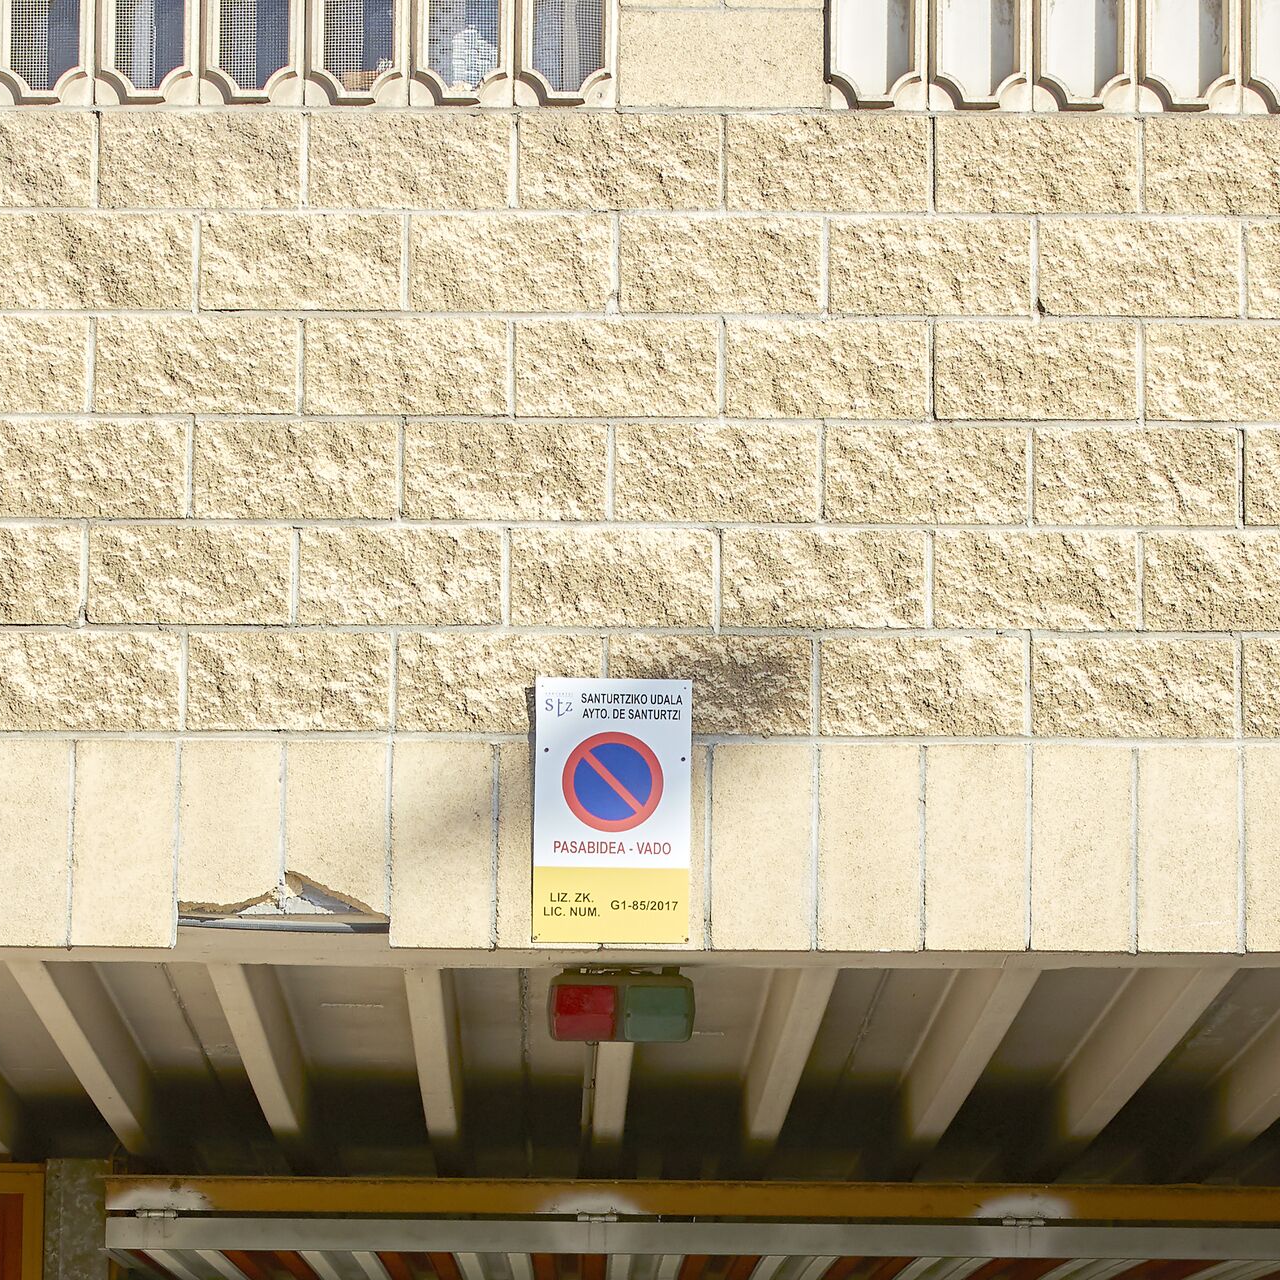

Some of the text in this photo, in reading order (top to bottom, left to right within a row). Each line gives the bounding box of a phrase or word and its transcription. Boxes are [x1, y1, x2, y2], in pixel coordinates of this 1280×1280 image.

[581, 693, 648, 705] SANTURTZIKO
[650, 694, 683, 706] UDALA
[582, 708, 681, 721] AYTO. DE SANTURTZI
[553, 840, 626, 855] PASABIDEA
[636, 841, 672, 855] VADO
[550, 892, 594, 903] LIZ. ZK.
[543, 906, 601, 917] LIC. NUM.
[610, 900, 679, 911] G1-85/2017
